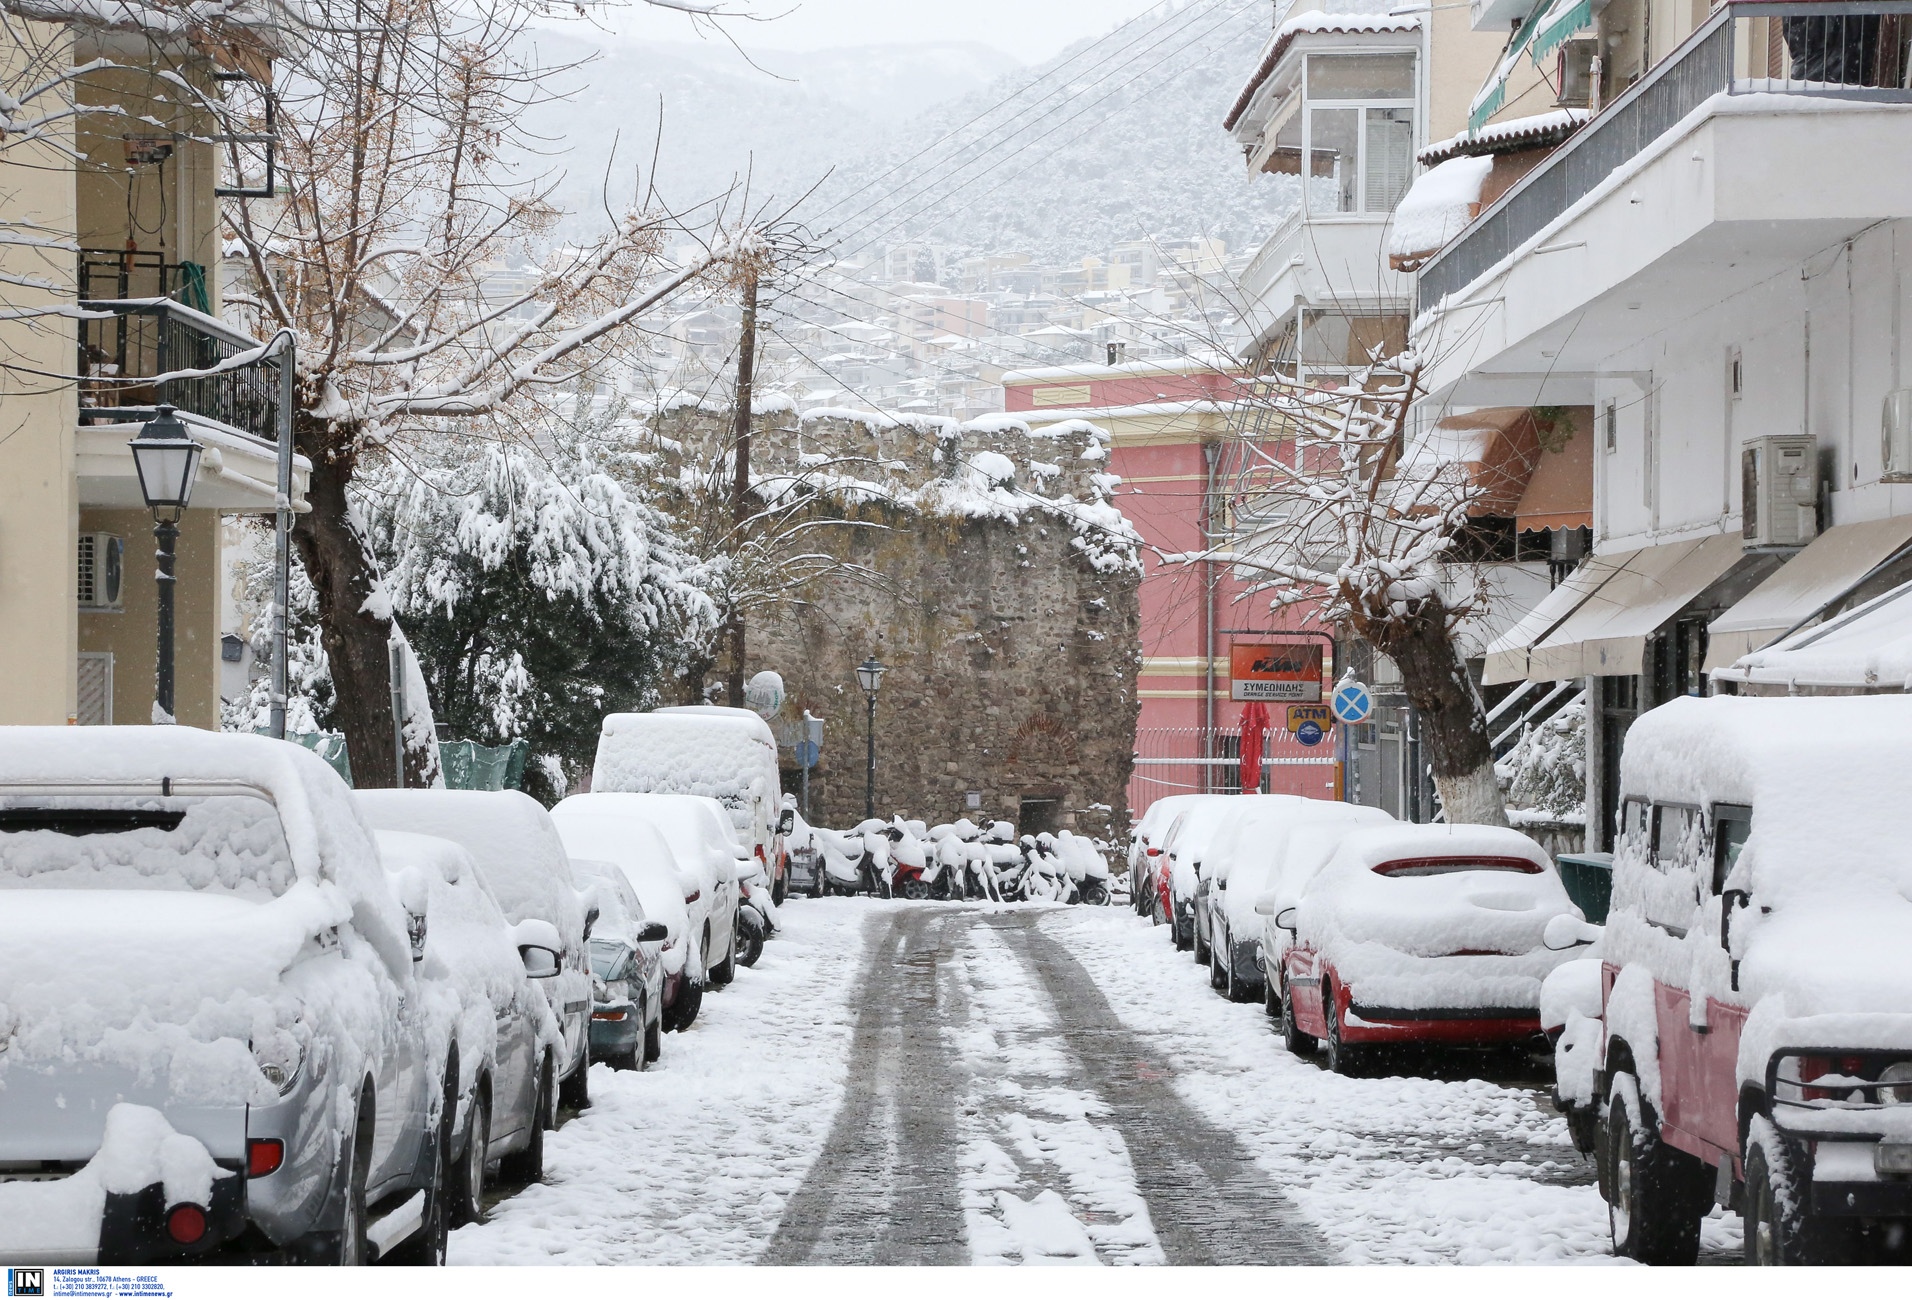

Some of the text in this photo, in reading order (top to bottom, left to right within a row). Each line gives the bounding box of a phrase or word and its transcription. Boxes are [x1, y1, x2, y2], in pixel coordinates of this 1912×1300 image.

[1251, 657, 1303, 672] KTM
[1243, 683, 1304, 692] ΣΥΜΕΩΝΙΔΗΣ
[1293, 708, 1327, 719] ATM
